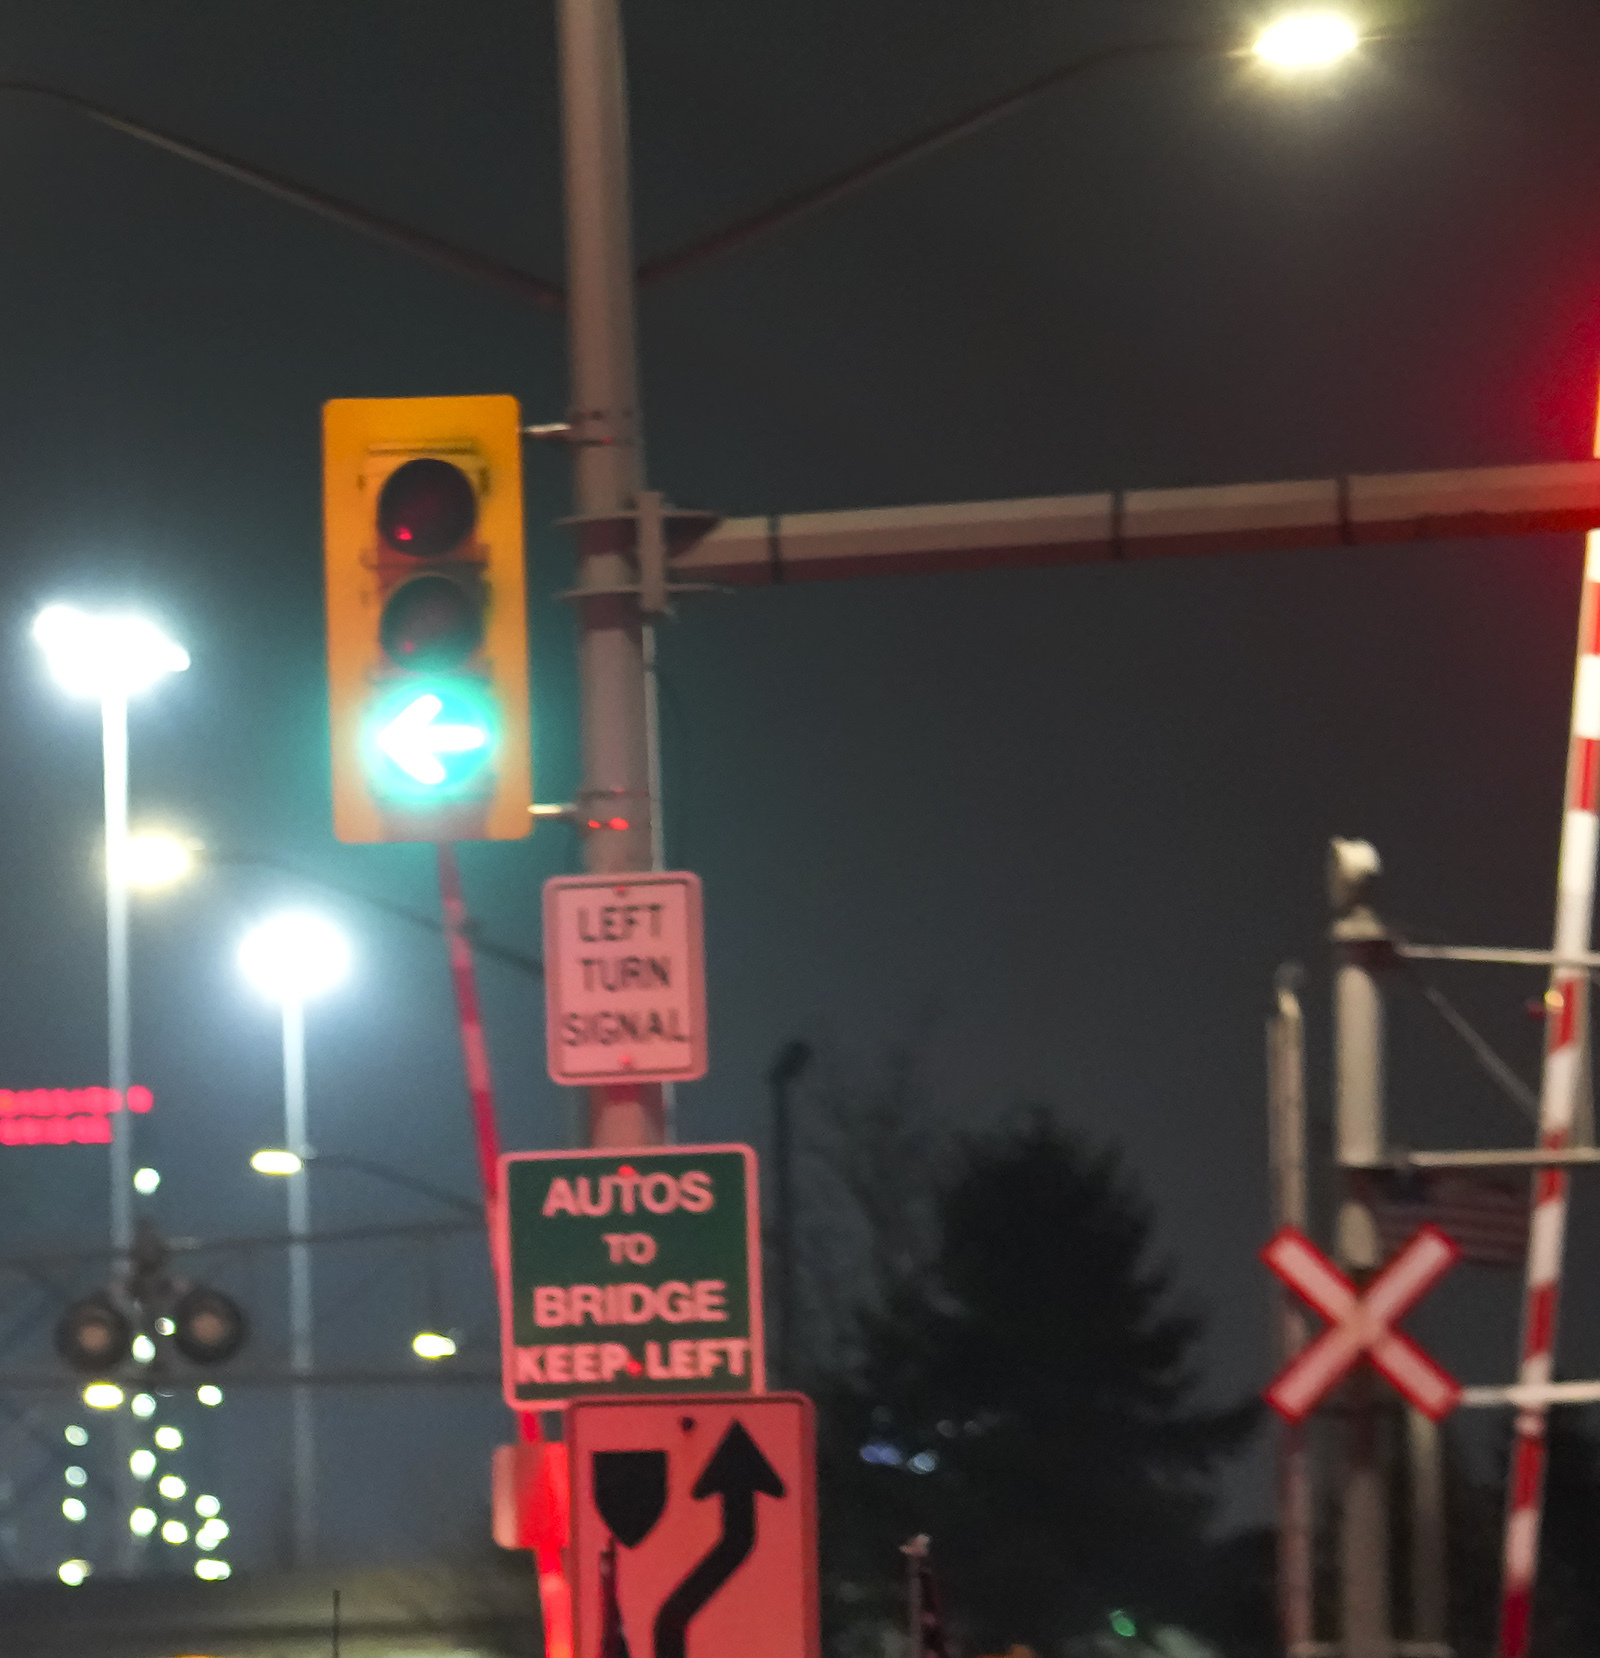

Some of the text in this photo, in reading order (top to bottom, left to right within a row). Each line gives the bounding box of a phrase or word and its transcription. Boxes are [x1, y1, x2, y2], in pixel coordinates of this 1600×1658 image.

[576, 904, 662, 942] LEFT
[577, 954, 671, 992] TURN
[561, 1008, 689, 1047] SIGNAL
[542, 1170, 715, 1217] AUTOS
[602, 1231, 657, 1265] TO
[533, 1279, 729, 1328] BRIDGE
[514, 1337, 749, 1384] KEEP LEFT
